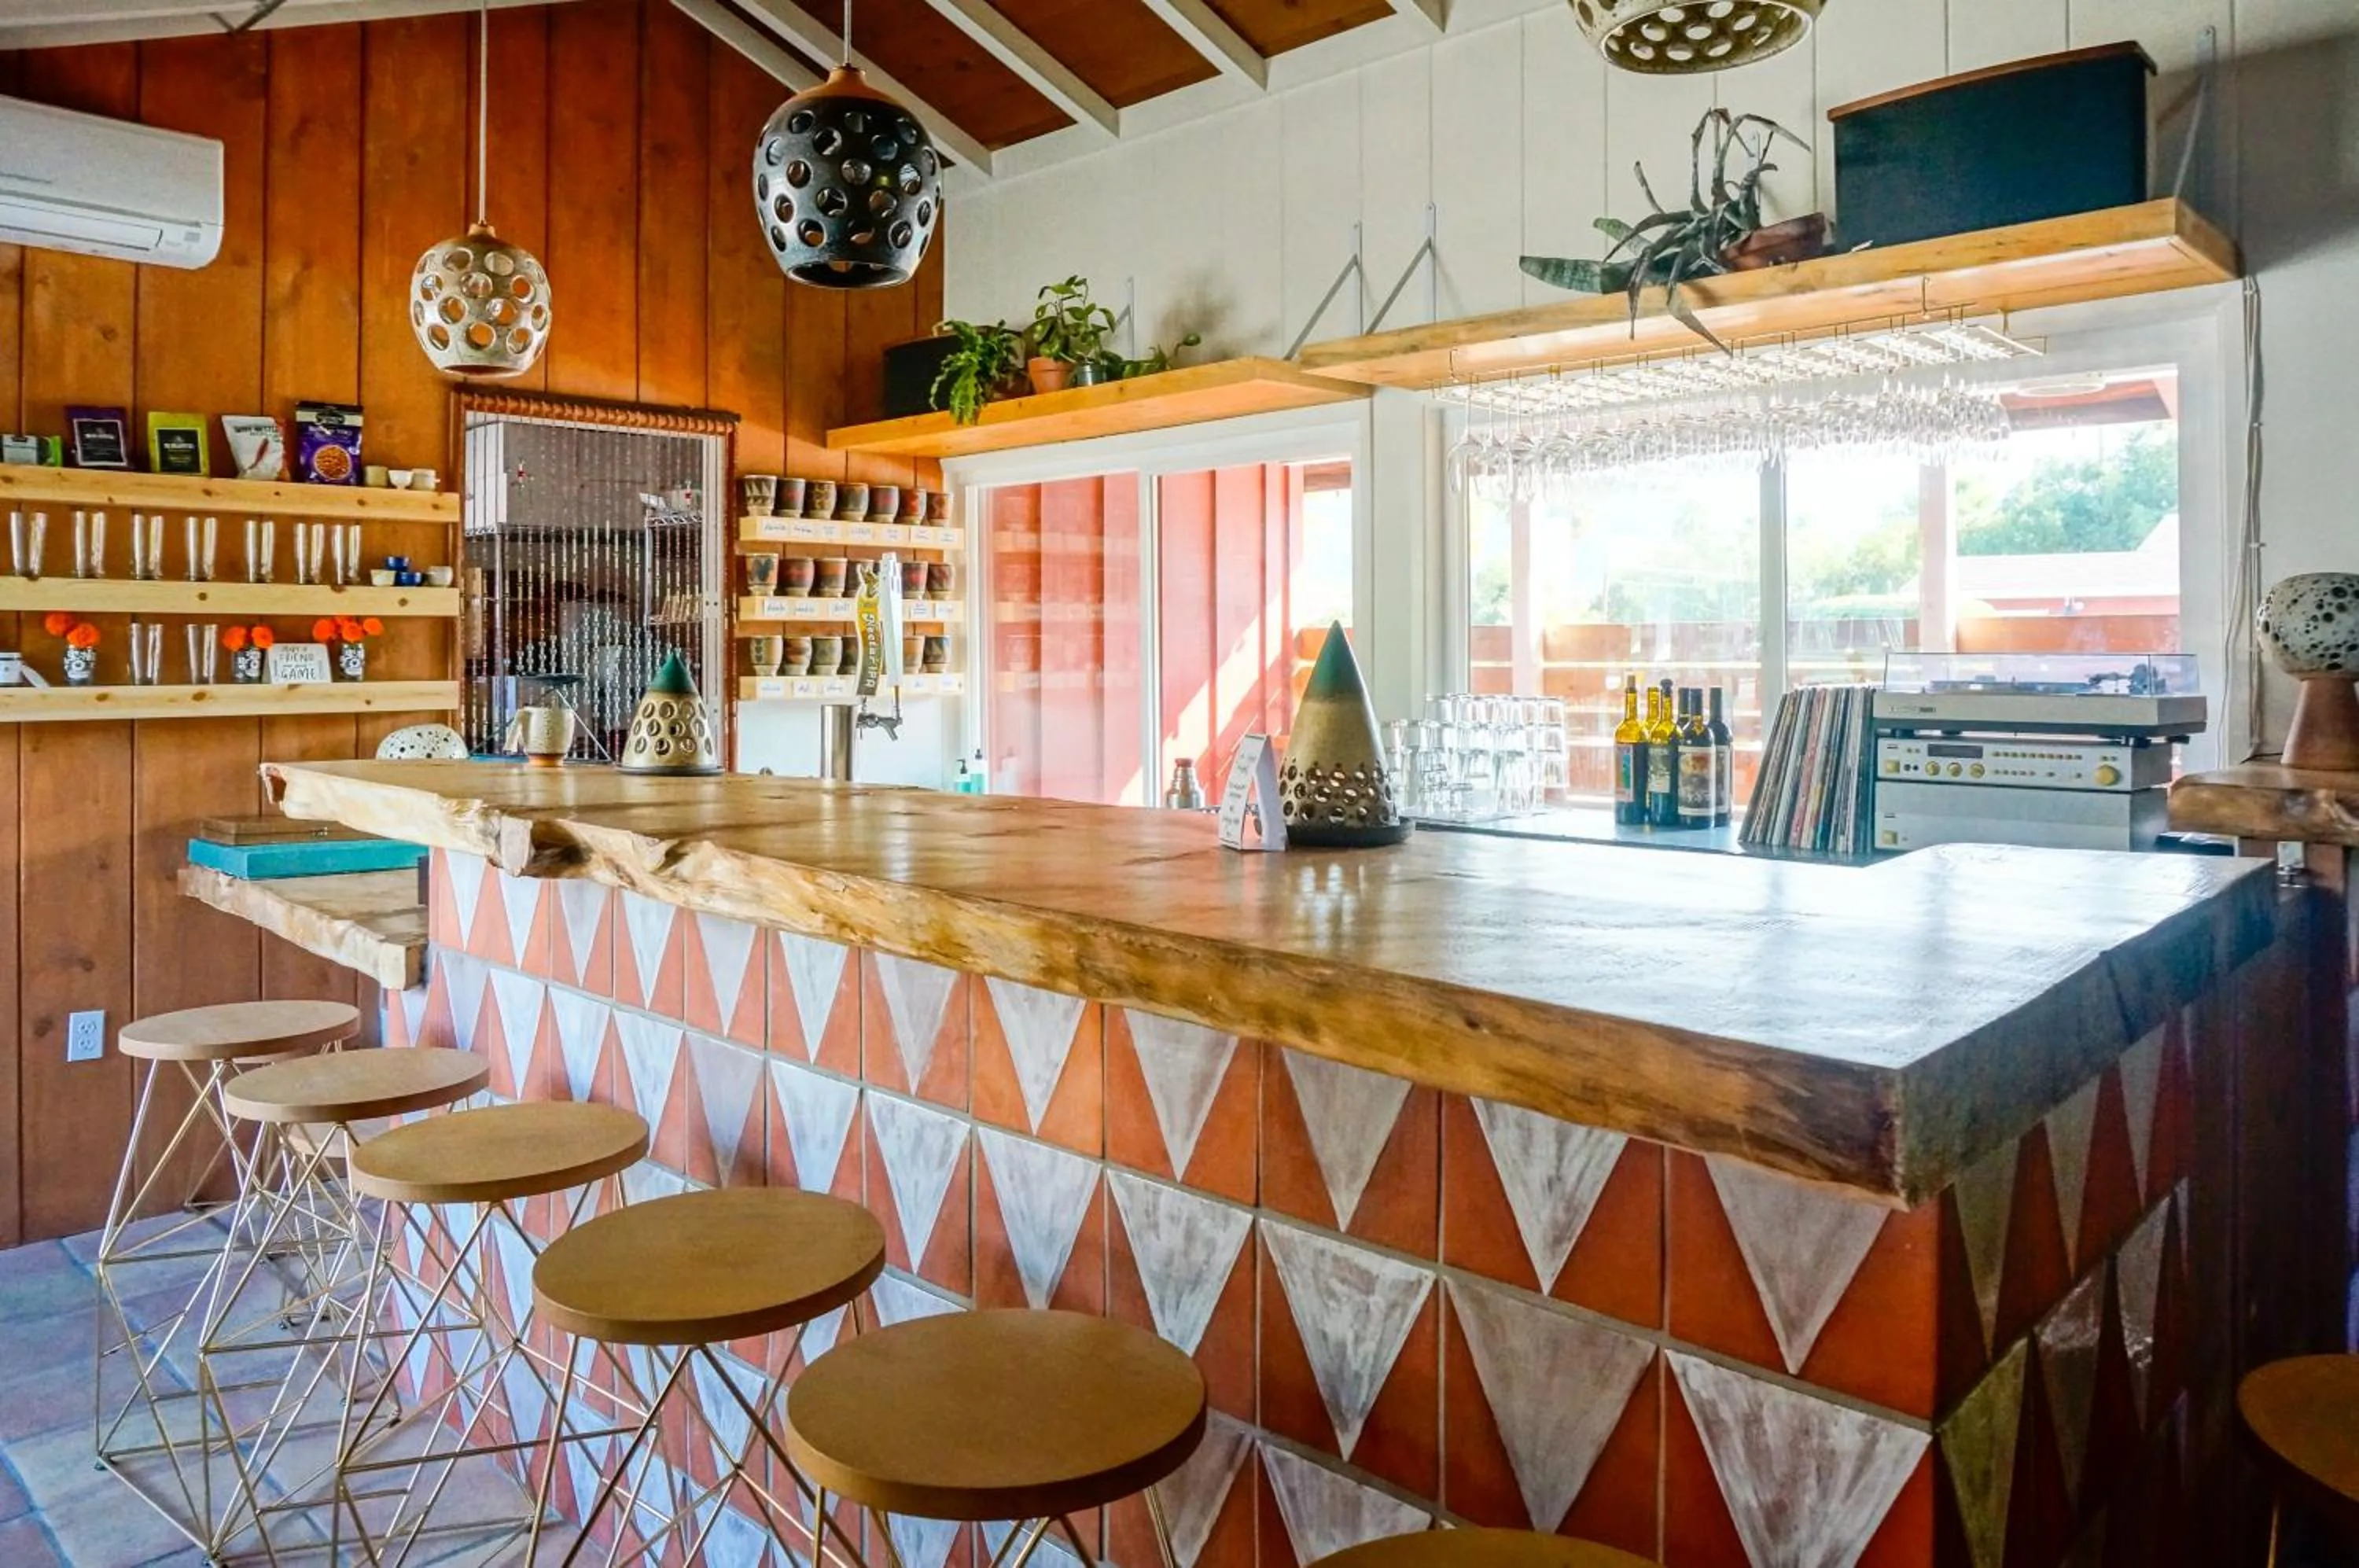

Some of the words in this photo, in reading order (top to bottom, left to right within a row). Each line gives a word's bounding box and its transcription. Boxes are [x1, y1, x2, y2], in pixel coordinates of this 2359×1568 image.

[279, 653, 315, 662] FRIEND
[278, 668, 316, 680] GAME
[865, 666, 878, 689] IPA
